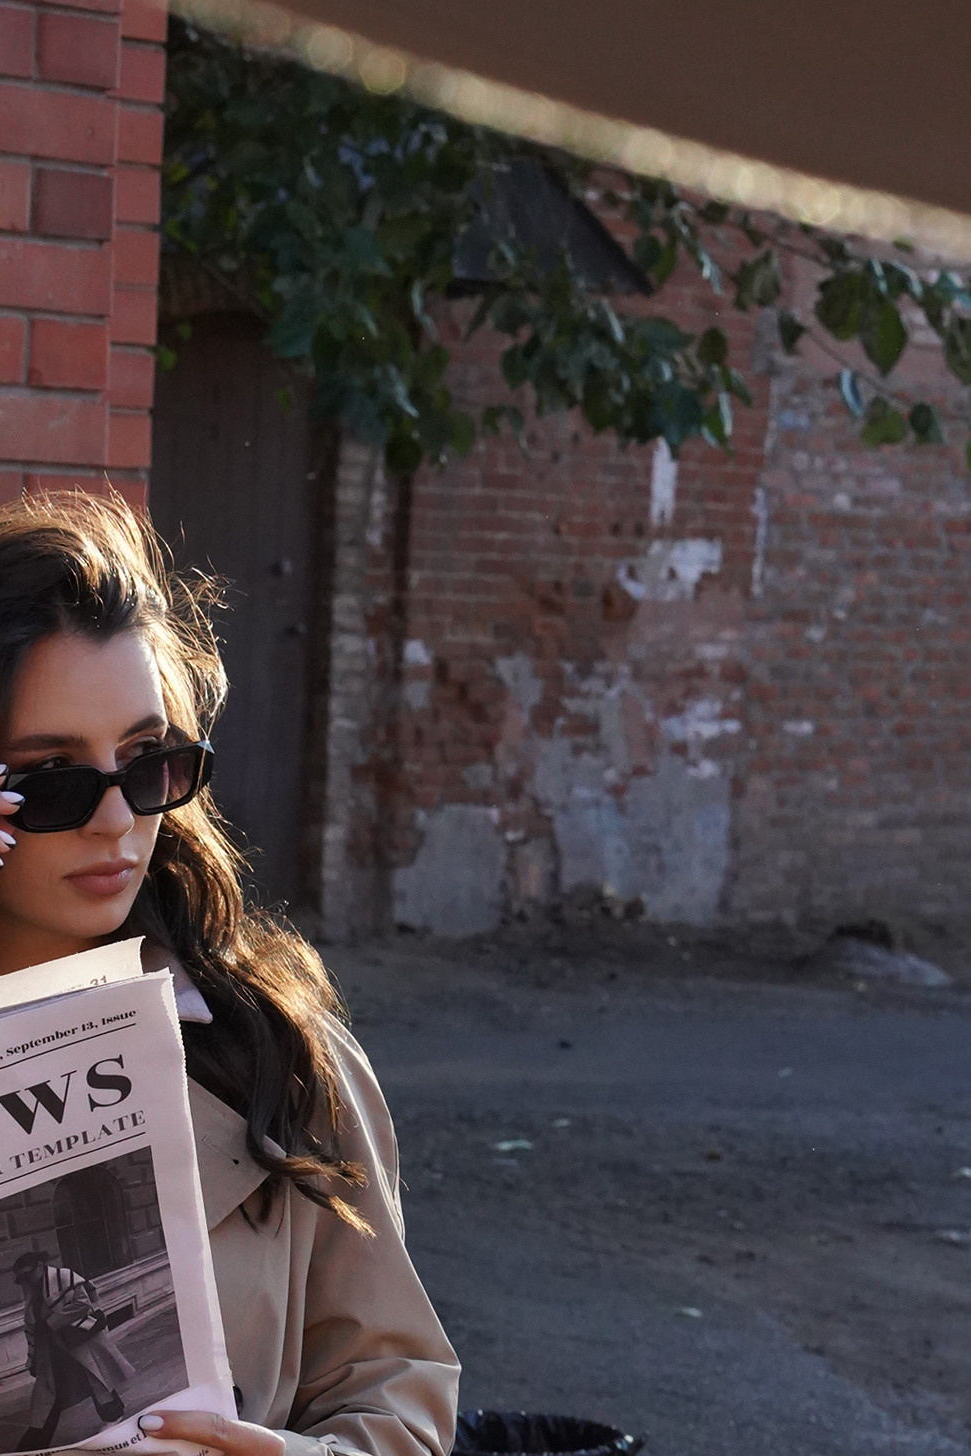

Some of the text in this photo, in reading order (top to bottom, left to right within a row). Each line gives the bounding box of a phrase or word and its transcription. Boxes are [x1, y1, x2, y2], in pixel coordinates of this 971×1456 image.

[6, 1027, 78, 1057] September
[101, 1006, 137, 1026] Issue
[9, 1111, 147, 1171] TEMPLATE
